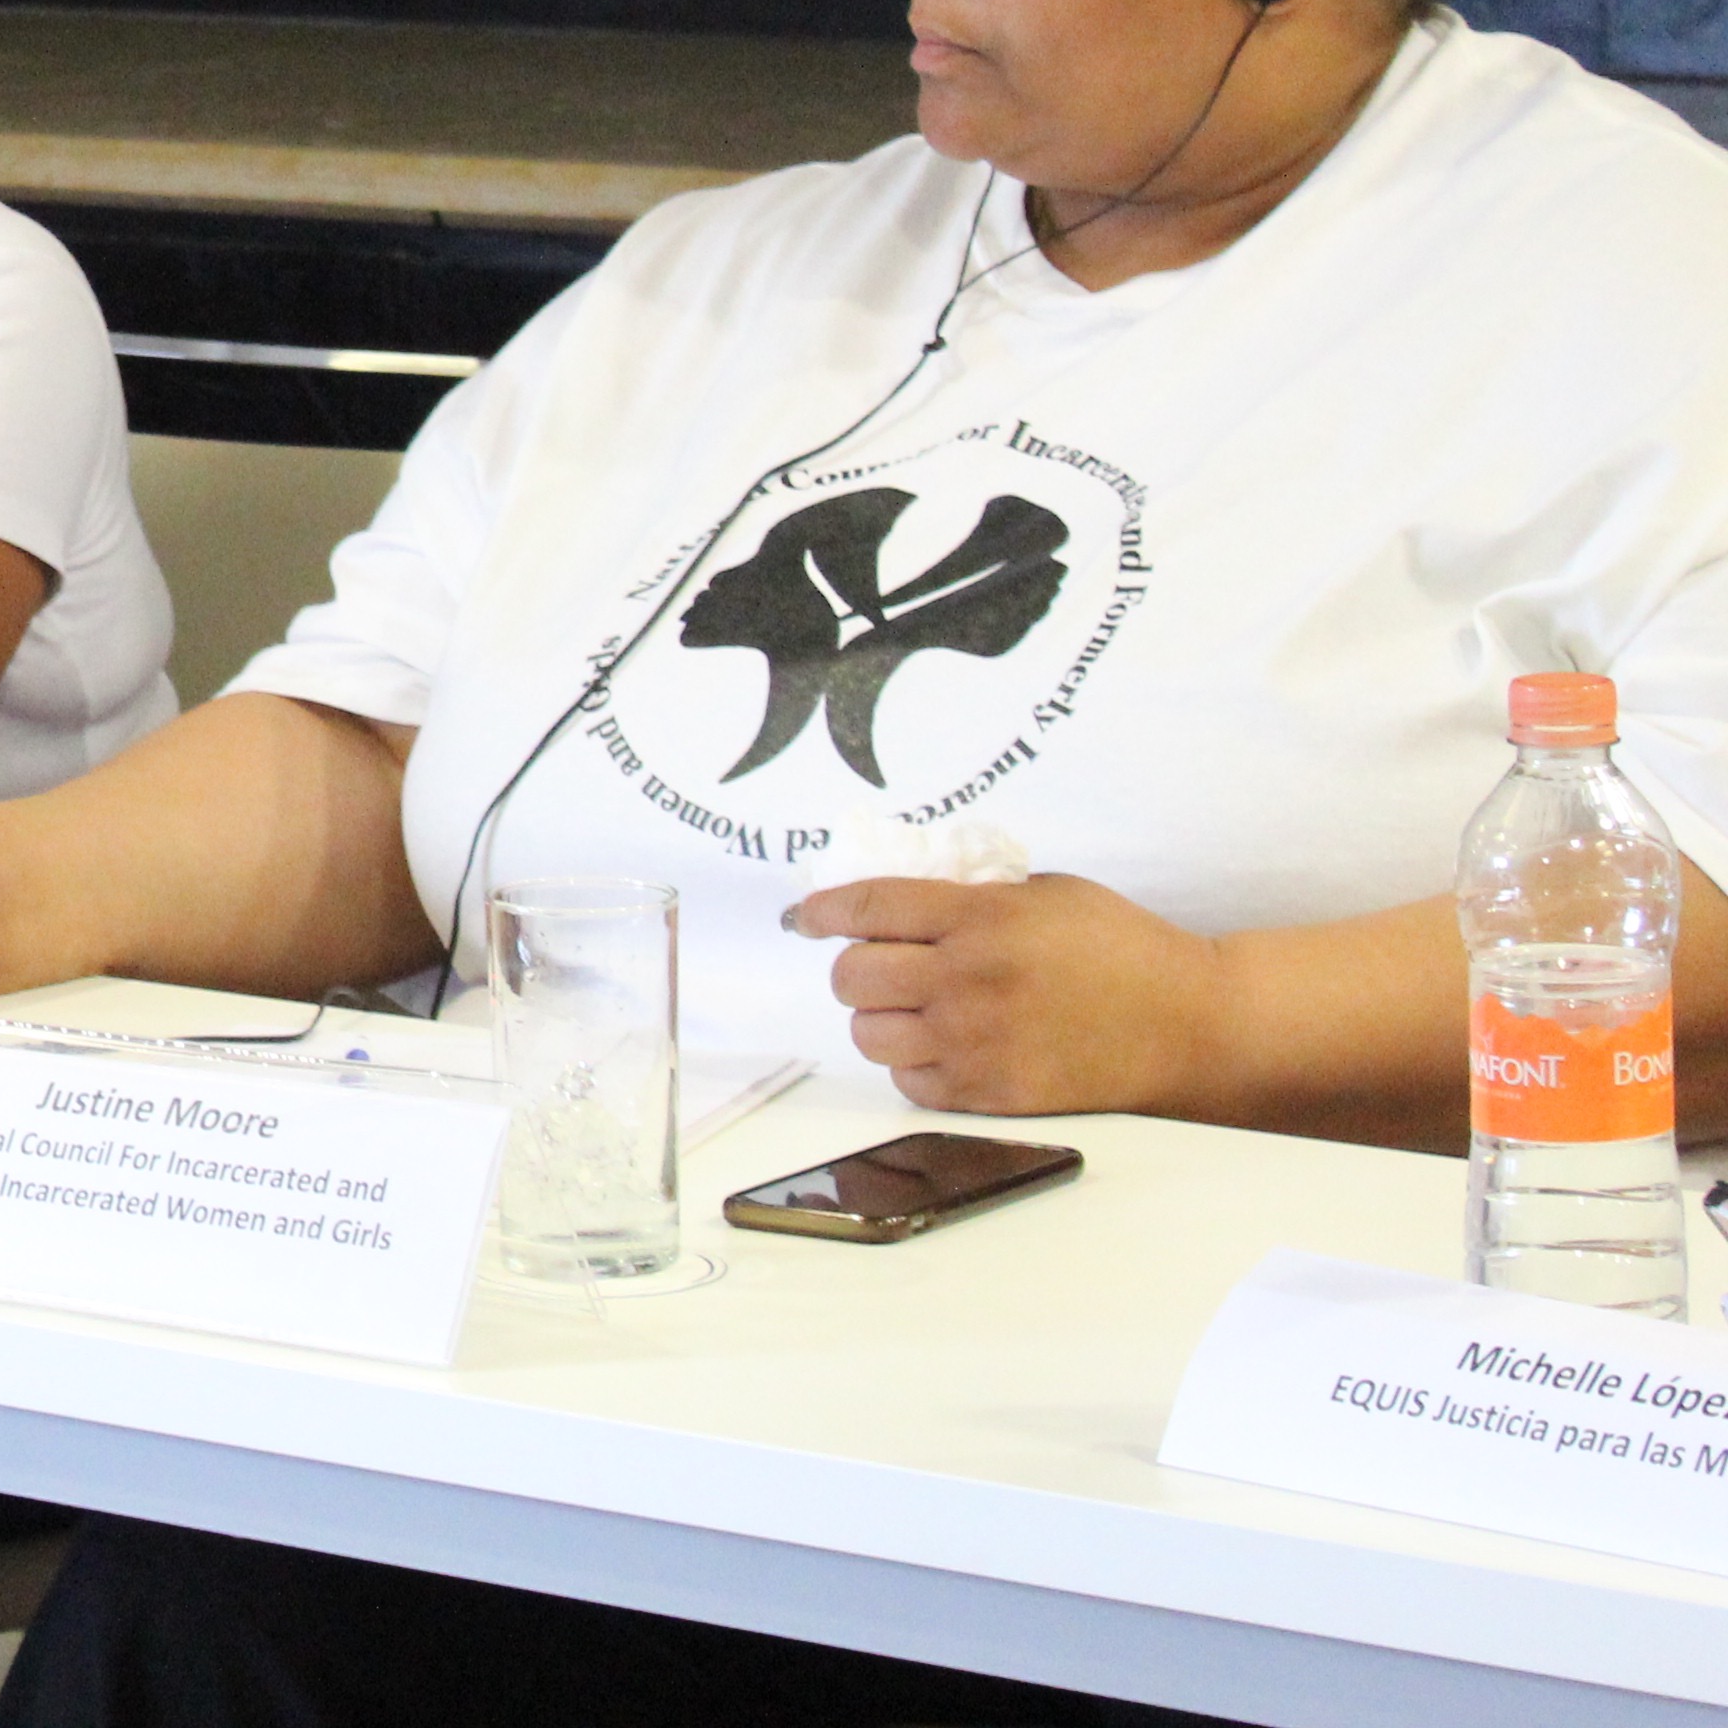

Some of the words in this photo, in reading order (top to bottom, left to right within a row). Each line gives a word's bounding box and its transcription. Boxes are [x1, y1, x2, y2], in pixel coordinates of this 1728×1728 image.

[1032, 584, 1148, 733] Formerly
[585, 714, 643, 776] and
[642, 774, 770, 862] Women
[36, 1081, 154, 1125] Justine
[163, 1097, 280, 1141] Moore
[20, 1131, 113, 1167] Council
[117, 1143, 161, 1173] For
[166, 1149, 331, 1196] Incarcerated
[336, 1174, 387, 1205] and
[0, 1172, 157, 1218] Incarcerated
[165, 1196, 265, 1233] Women
[272, 1210, 324, 1242] and
[331, 1219, 392, 1251] Girls
[1455, 1340, 1623, 1399] Michelle
[1330, 1375, 1429, 1418] EQUIS
[1432, 1393, 1549, 1442] Justicia
[1555, 1421, 1632, 1458] para
[1640, 1432, 1686, 1469] las
[1694, 1443, 1728, 1478] M
